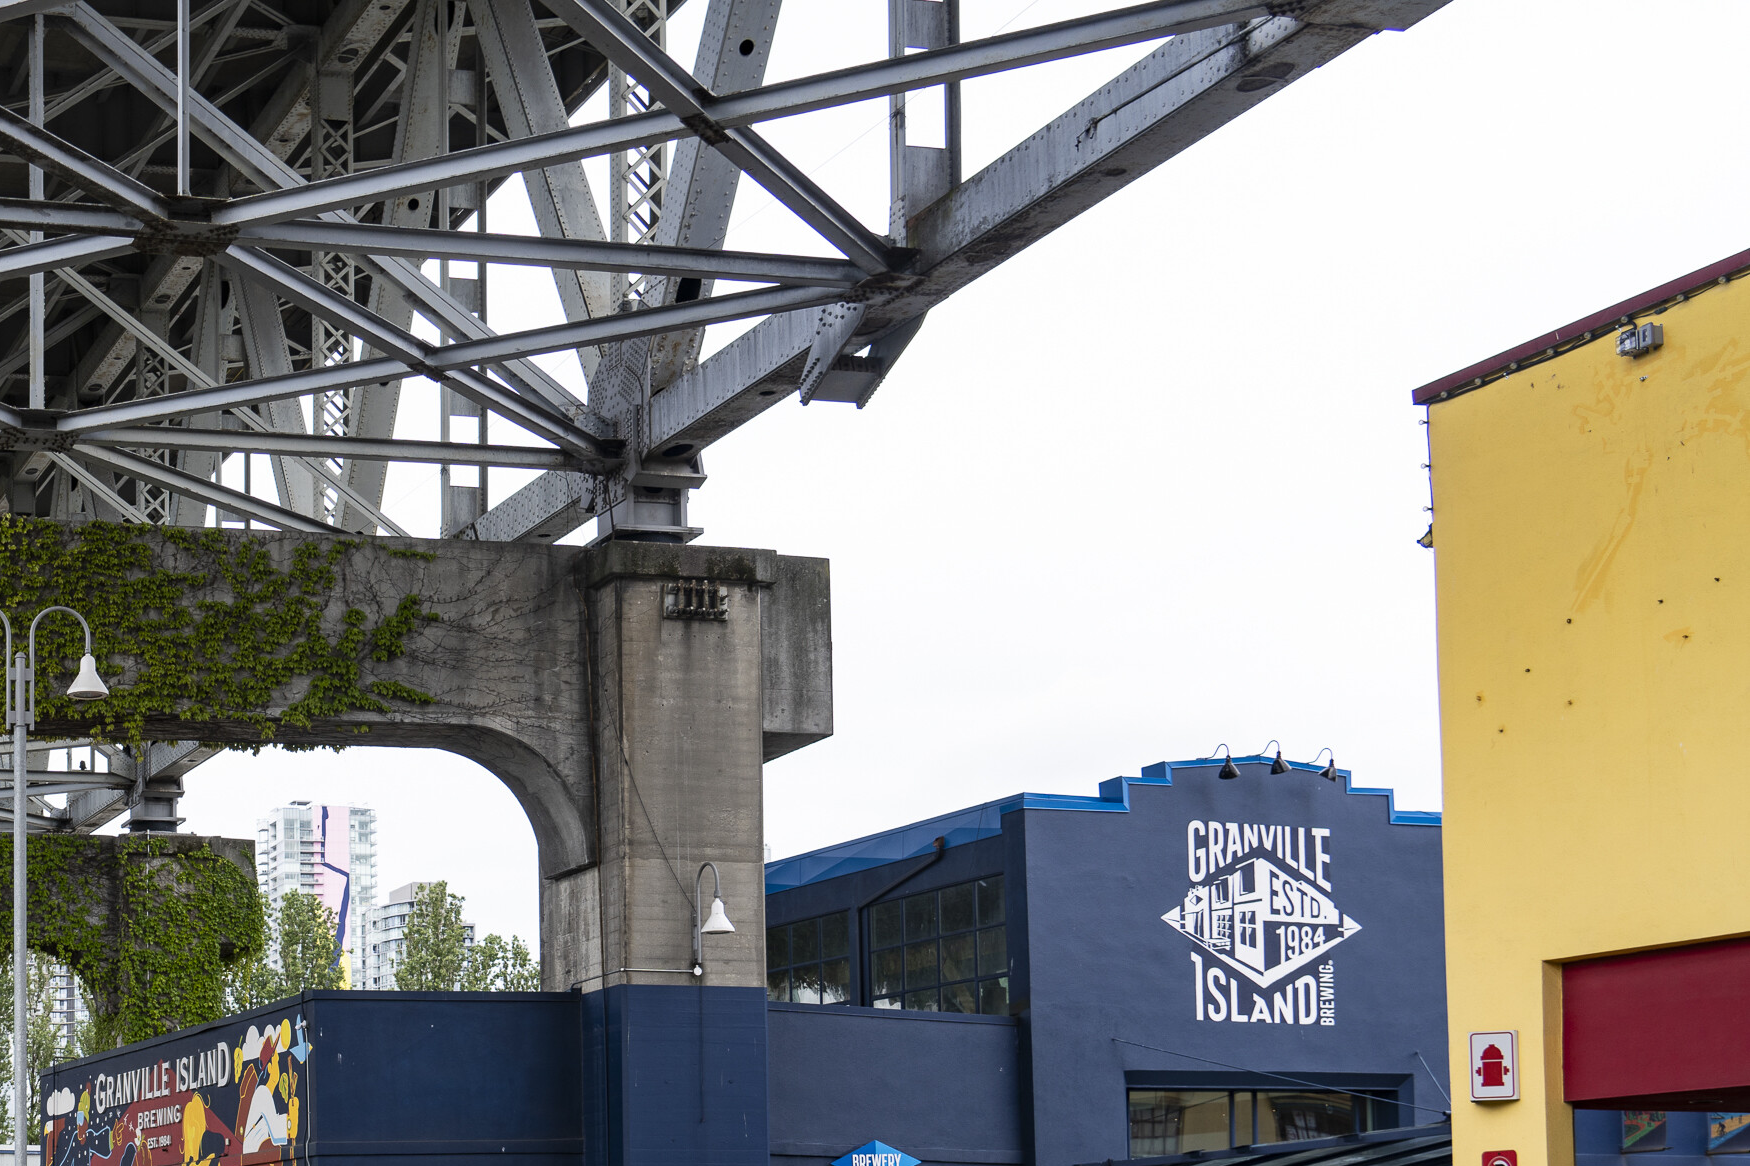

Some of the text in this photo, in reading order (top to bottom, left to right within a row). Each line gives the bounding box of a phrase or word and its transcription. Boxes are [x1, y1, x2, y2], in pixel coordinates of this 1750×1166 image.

[1187, 820, 1332, 893] GRANVILLE
[1270, 869, 1328, 920] ESTD.
[1275, 925, 1326, 963] 1984
[1190, 951, 1318, 1025] ISLAND
[95, 1041, 232, 1114] GRANVILLE ISLAND
[137, 1104, 182, 1130] BREWING
